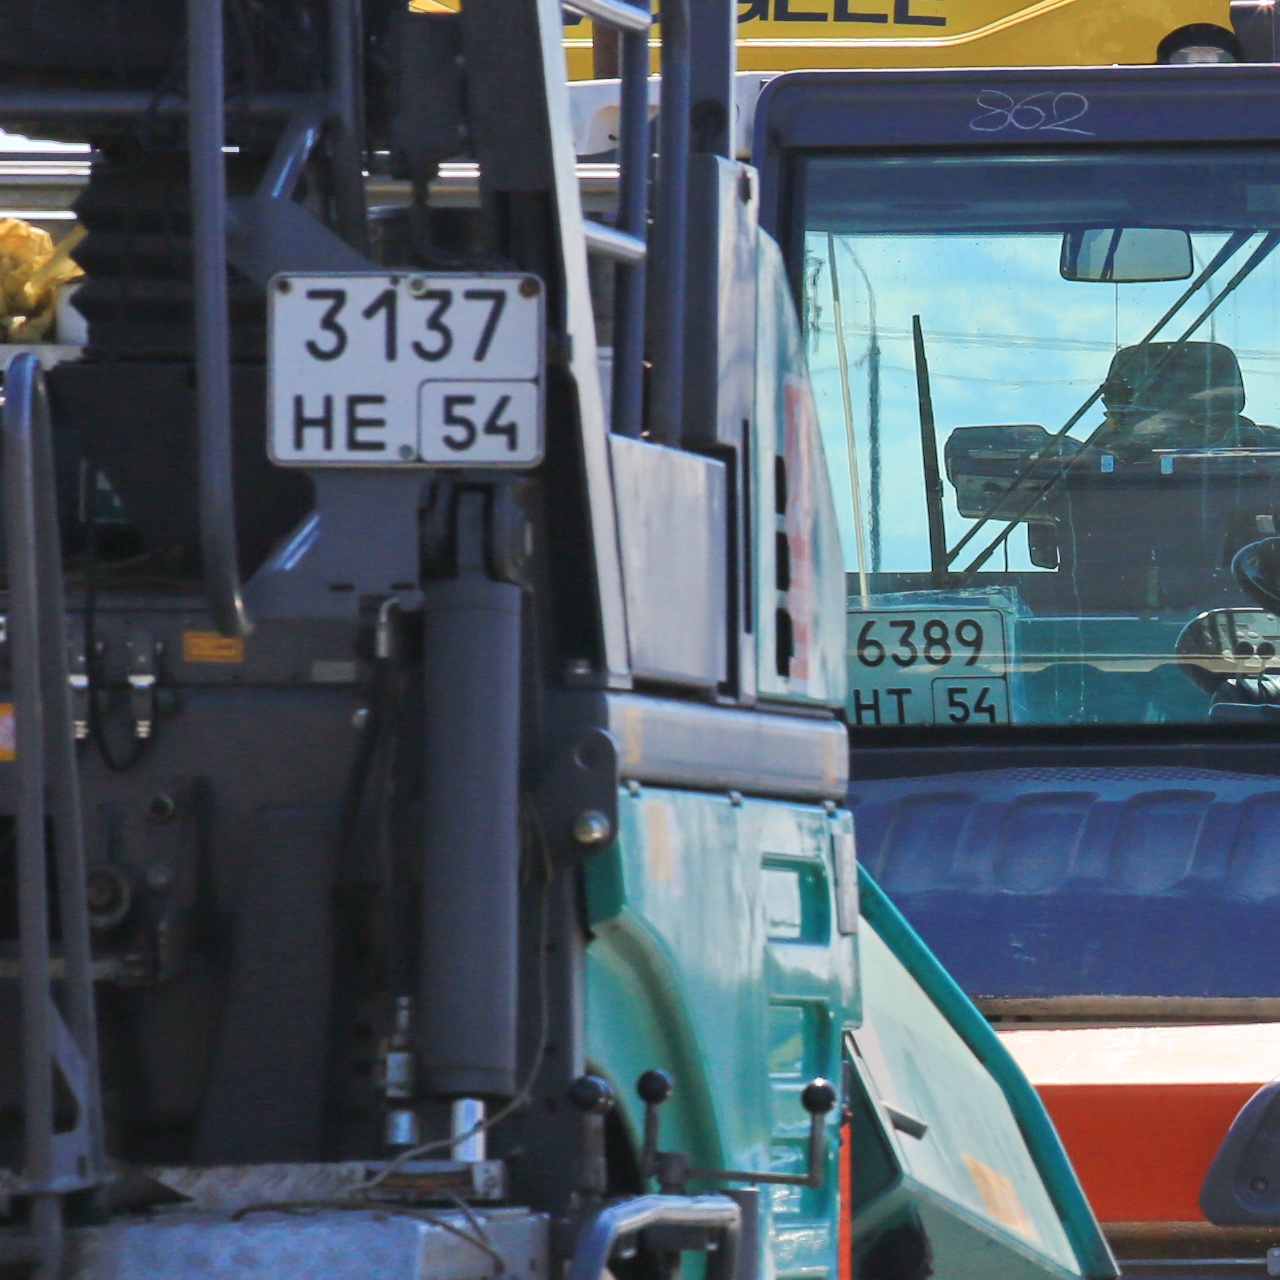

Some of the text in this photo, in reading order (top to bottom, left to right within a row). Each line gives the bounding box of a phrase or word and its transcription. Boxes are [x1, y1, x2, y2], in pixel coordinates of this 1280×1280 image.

[305, 288, 507, 363] 3137
[442, 394, 518, 452] 54
[857, 618, 984, 667] 6389
[947, 686, 996, 724] 54
